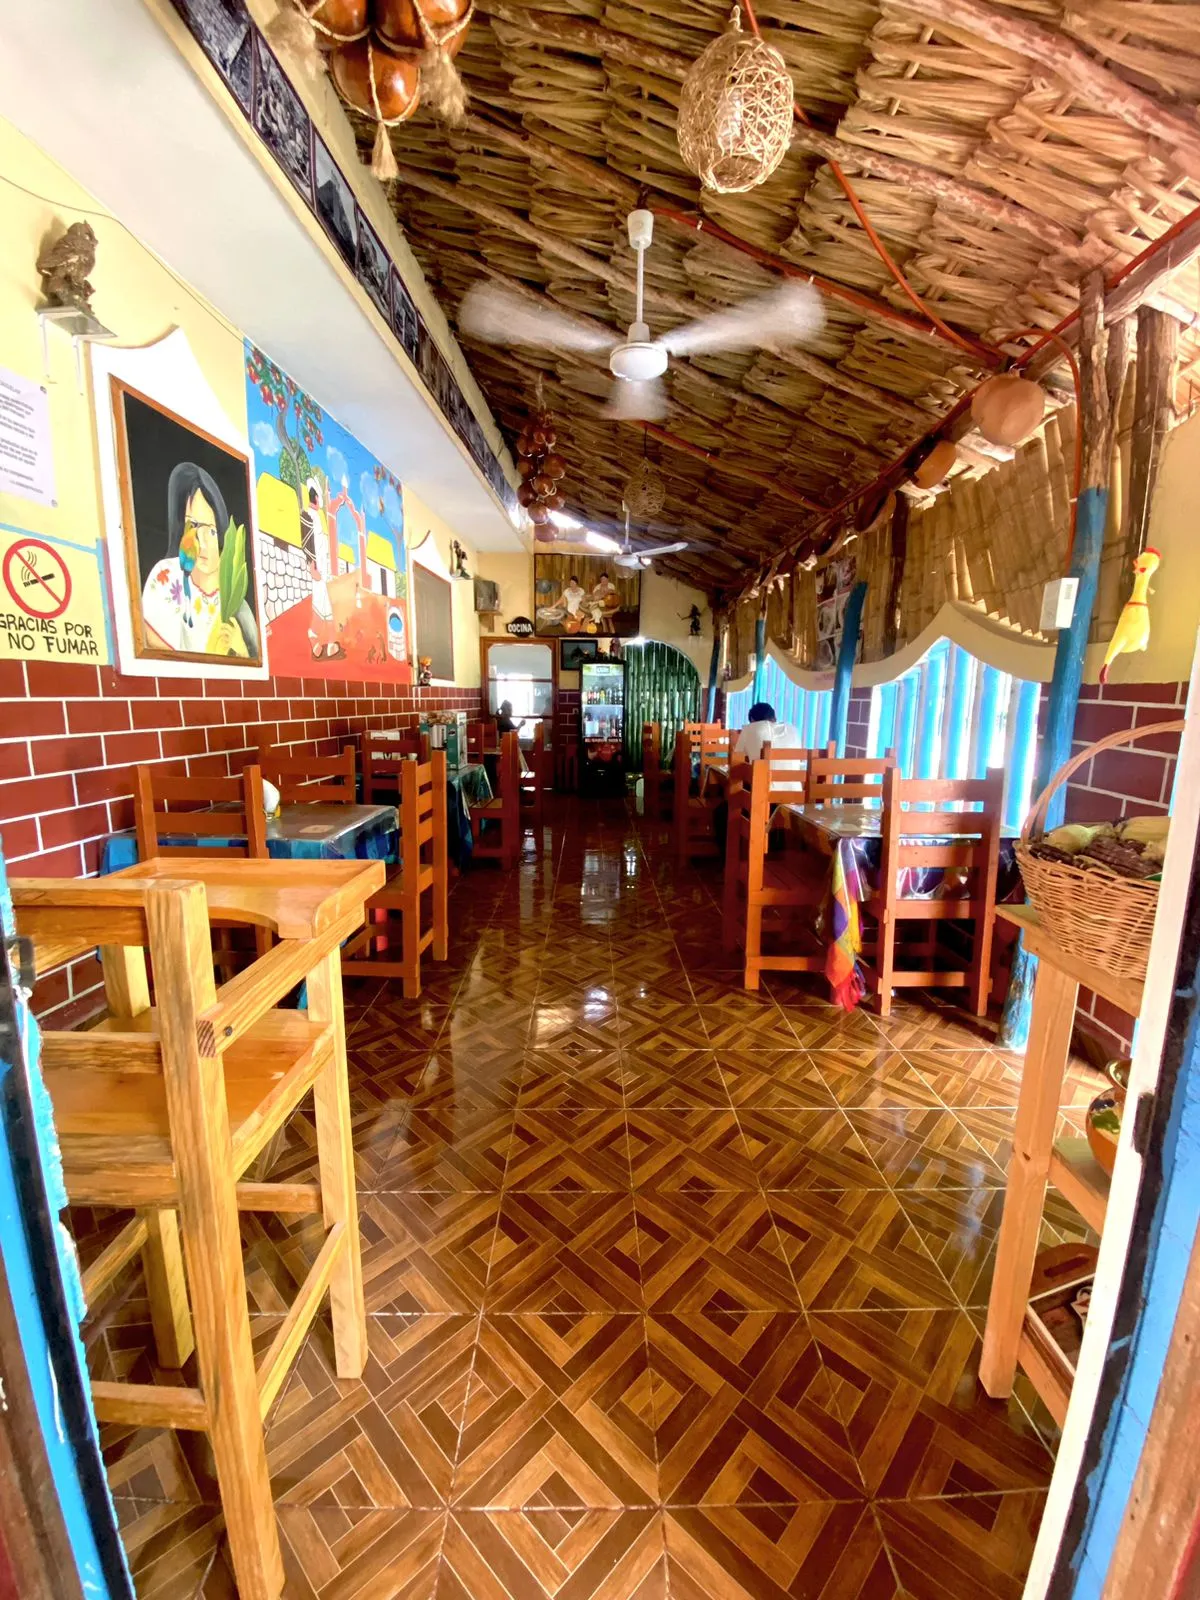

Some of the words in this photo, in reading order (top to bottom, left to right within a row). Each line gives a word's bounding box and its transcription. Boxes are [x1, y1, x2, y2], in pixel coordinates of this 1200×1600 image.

[64, 622, 93, 638] POR
[507, 623, 533, 633] COCINA
[8, 632, 35, 651] NO
[43, 636, 99, 656] FUMAR
